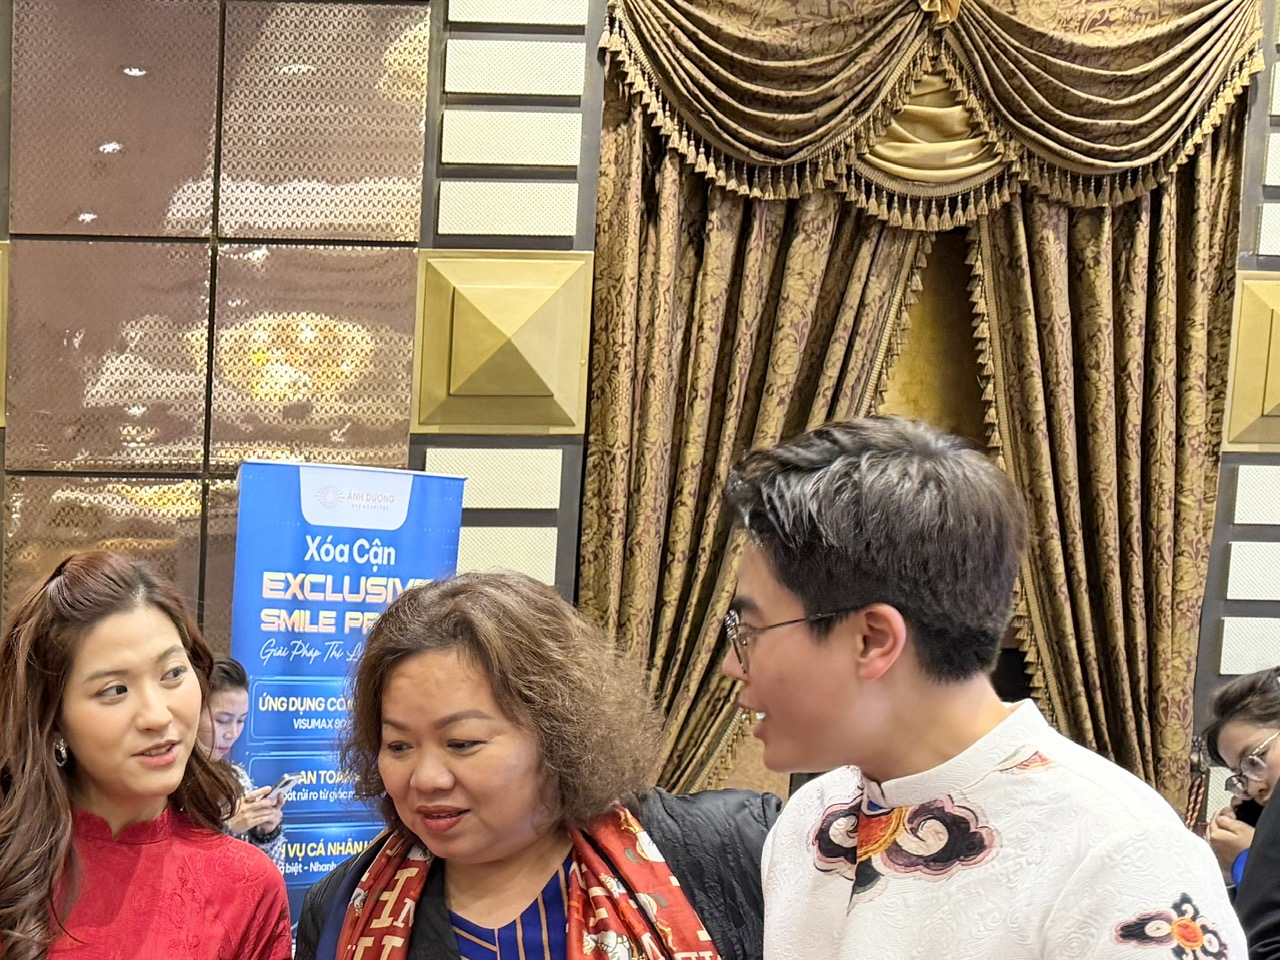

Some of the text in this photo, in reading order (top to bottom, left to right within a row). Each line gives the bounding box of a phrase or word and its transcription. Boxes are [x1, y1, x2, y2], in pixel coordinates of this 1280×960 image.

[304, 535, 396, 573] Xóa Cận
[260, 608, 336, 634] SMILE
[290, 640, 322, 665] Pháp
[258, 692, 289, 712] ỨNG
[289, 697, 326, 716] DỤNG
[293, 718, 334, 730] VISUMAX
[298, 770, 317, 785] AN
[287, 843, 306, 861] VỤ
[307, 839, 326, 856] CÁ
[327, 838, 363, 856] NHÂN
[286, 861, 303, 876] biệt
